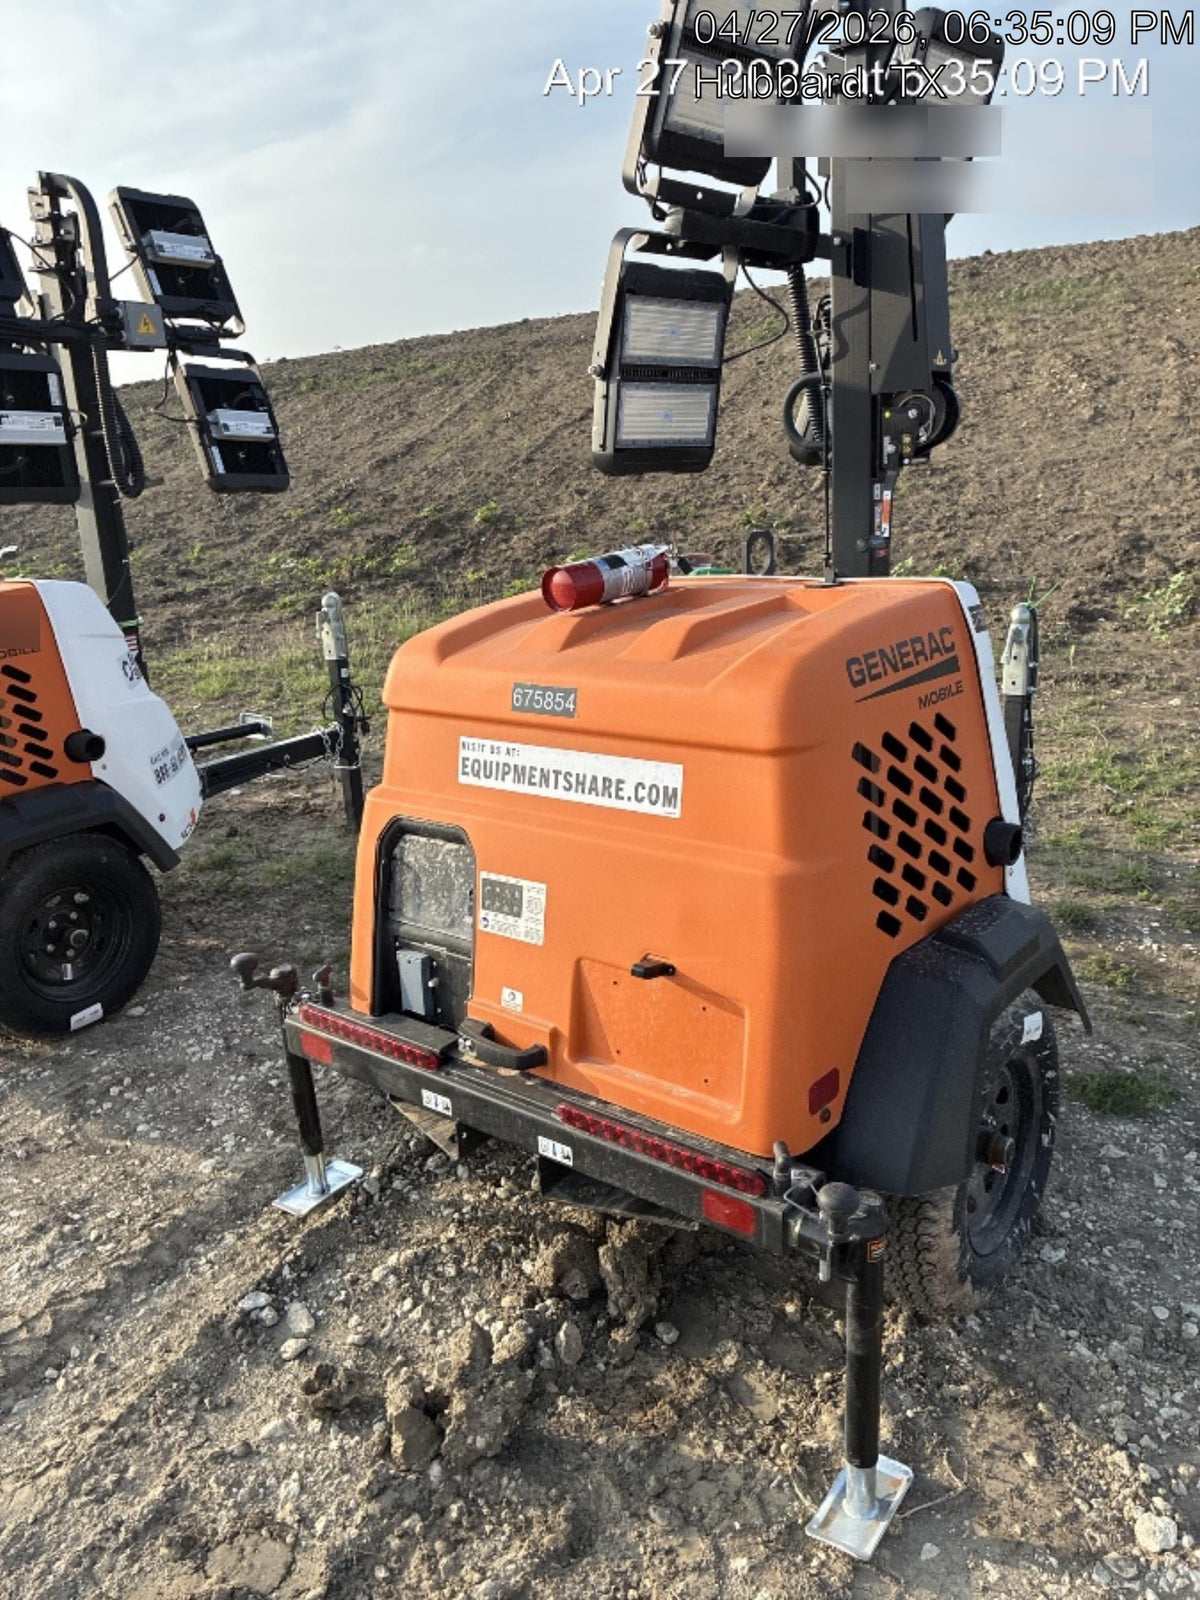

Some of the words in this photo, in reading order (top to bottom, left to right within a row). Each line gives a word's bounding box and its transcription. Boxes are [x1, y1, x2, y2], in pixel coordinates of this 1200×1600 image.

[845, 626, 956, 688] GENERAC
[512, 688, 576, 712] 675854
[917, 680, 964, 709] MOBILE
[461, 757, 679, 810] EQUIPMENTSHARE.COM
